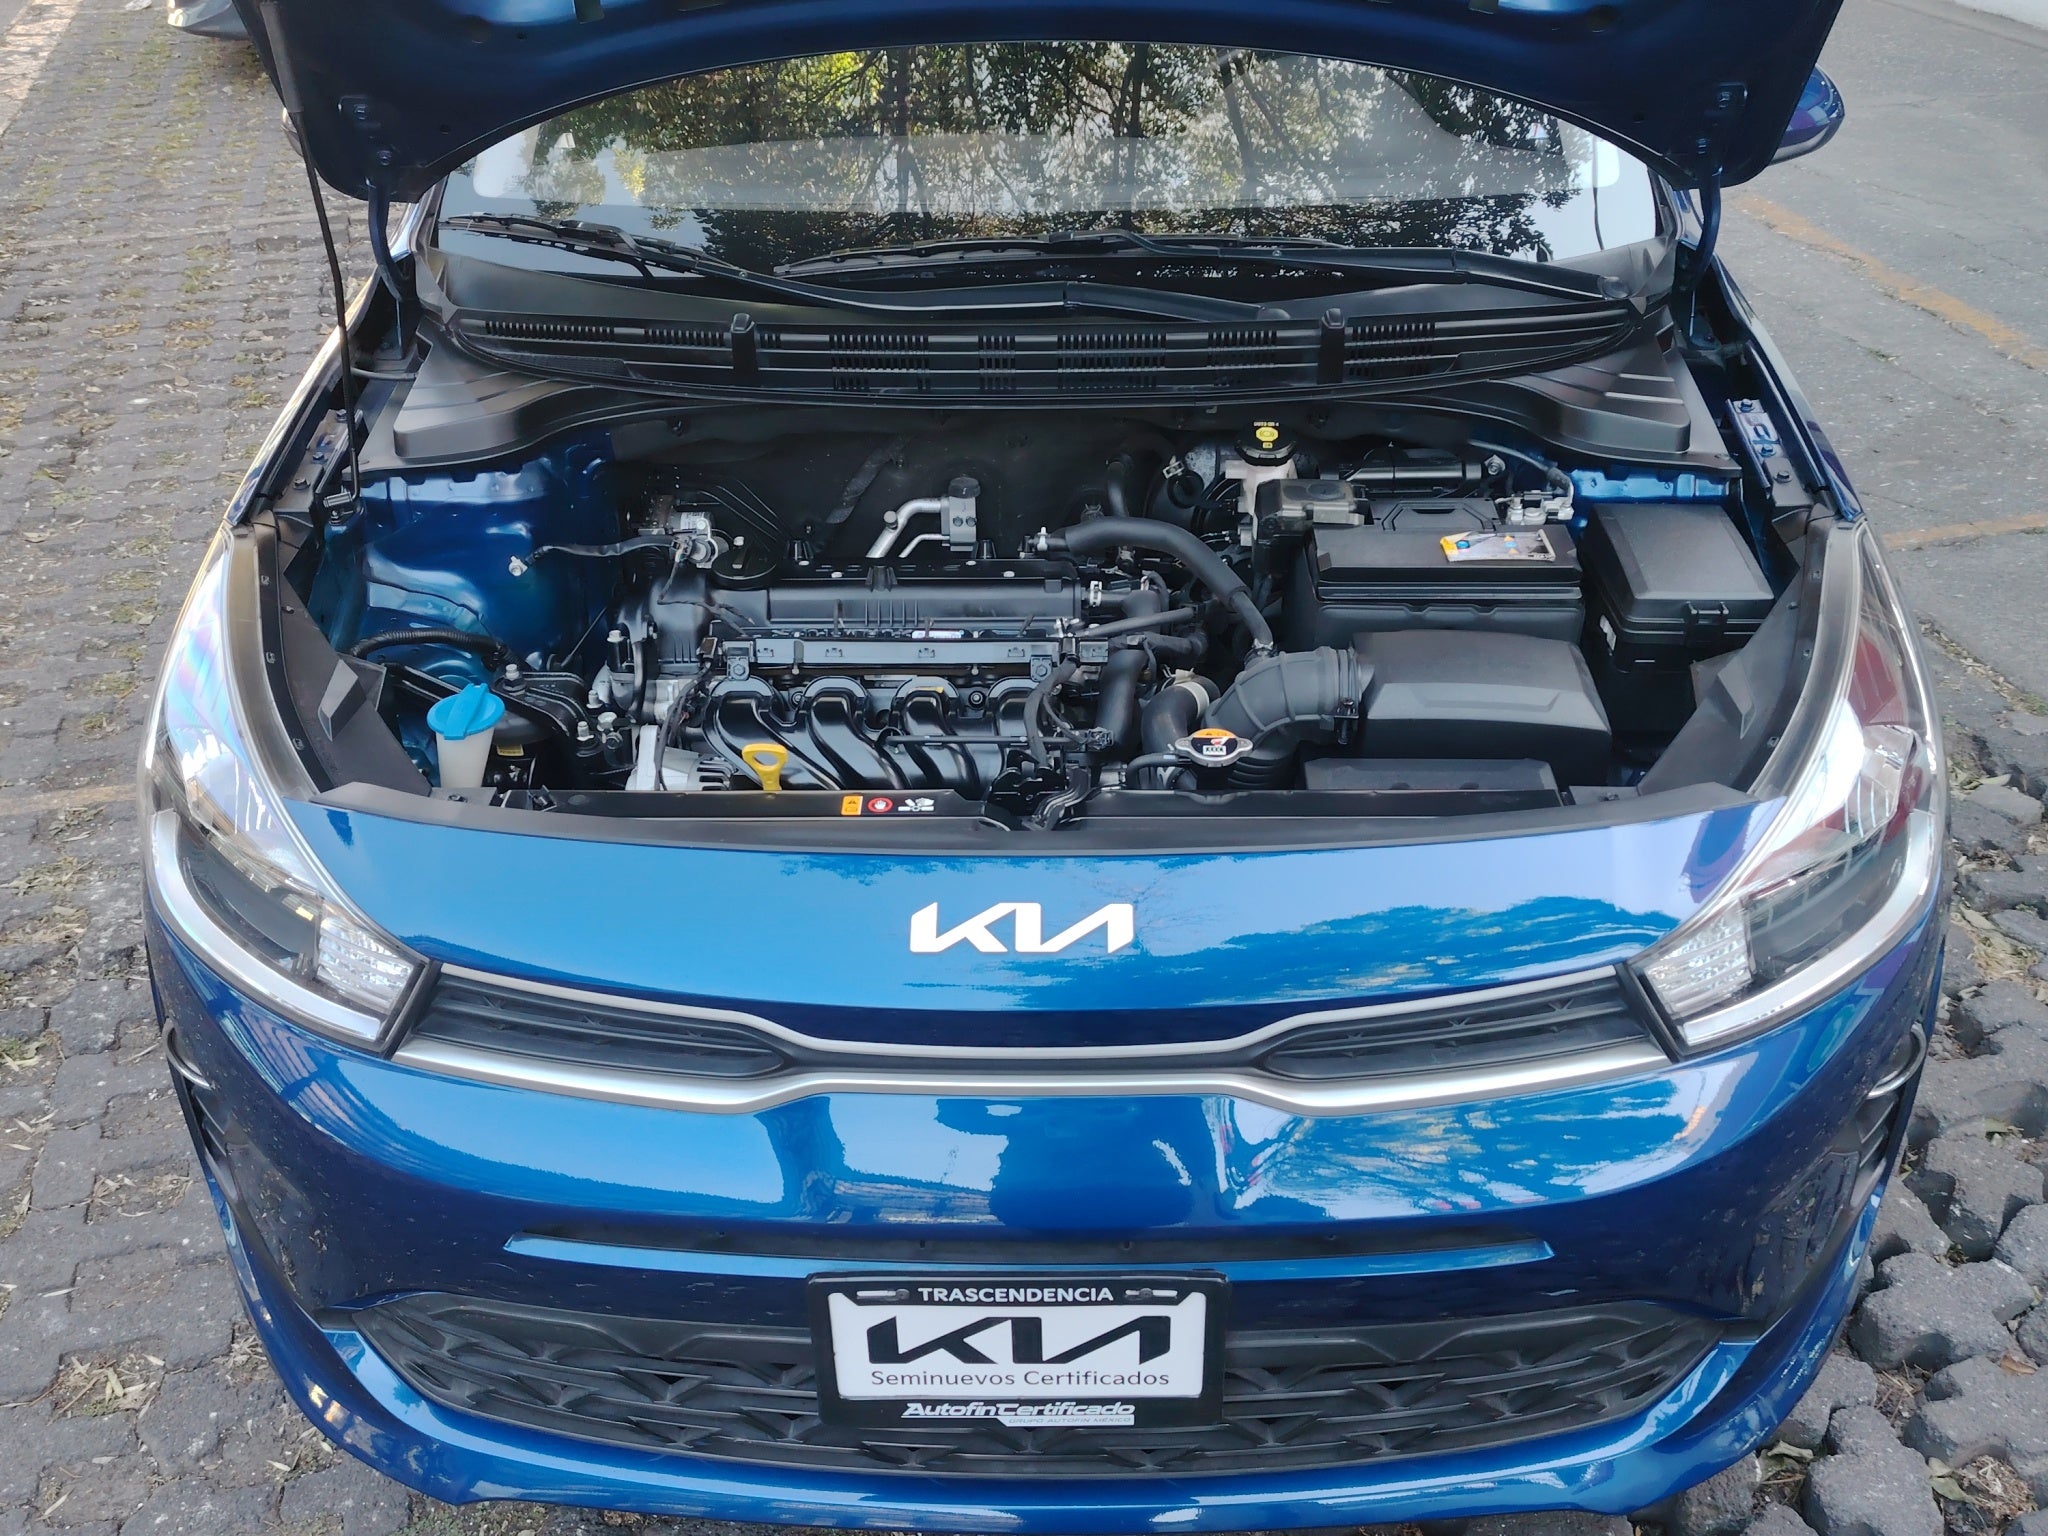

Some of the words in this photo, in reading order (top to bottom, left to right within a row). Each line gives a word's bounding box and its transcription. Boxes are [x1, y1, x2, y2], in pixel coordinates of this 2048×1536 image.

[910, 903, 1134, 953] KIA
[918, 1288, 1114, 1303] TRASCENDENCIA
[867, 1316, 1171, 1364] KIA
[871, 1370, 1015, 1386] Seminuevos
[1024, 1370, 1170, 1386] Certificados
